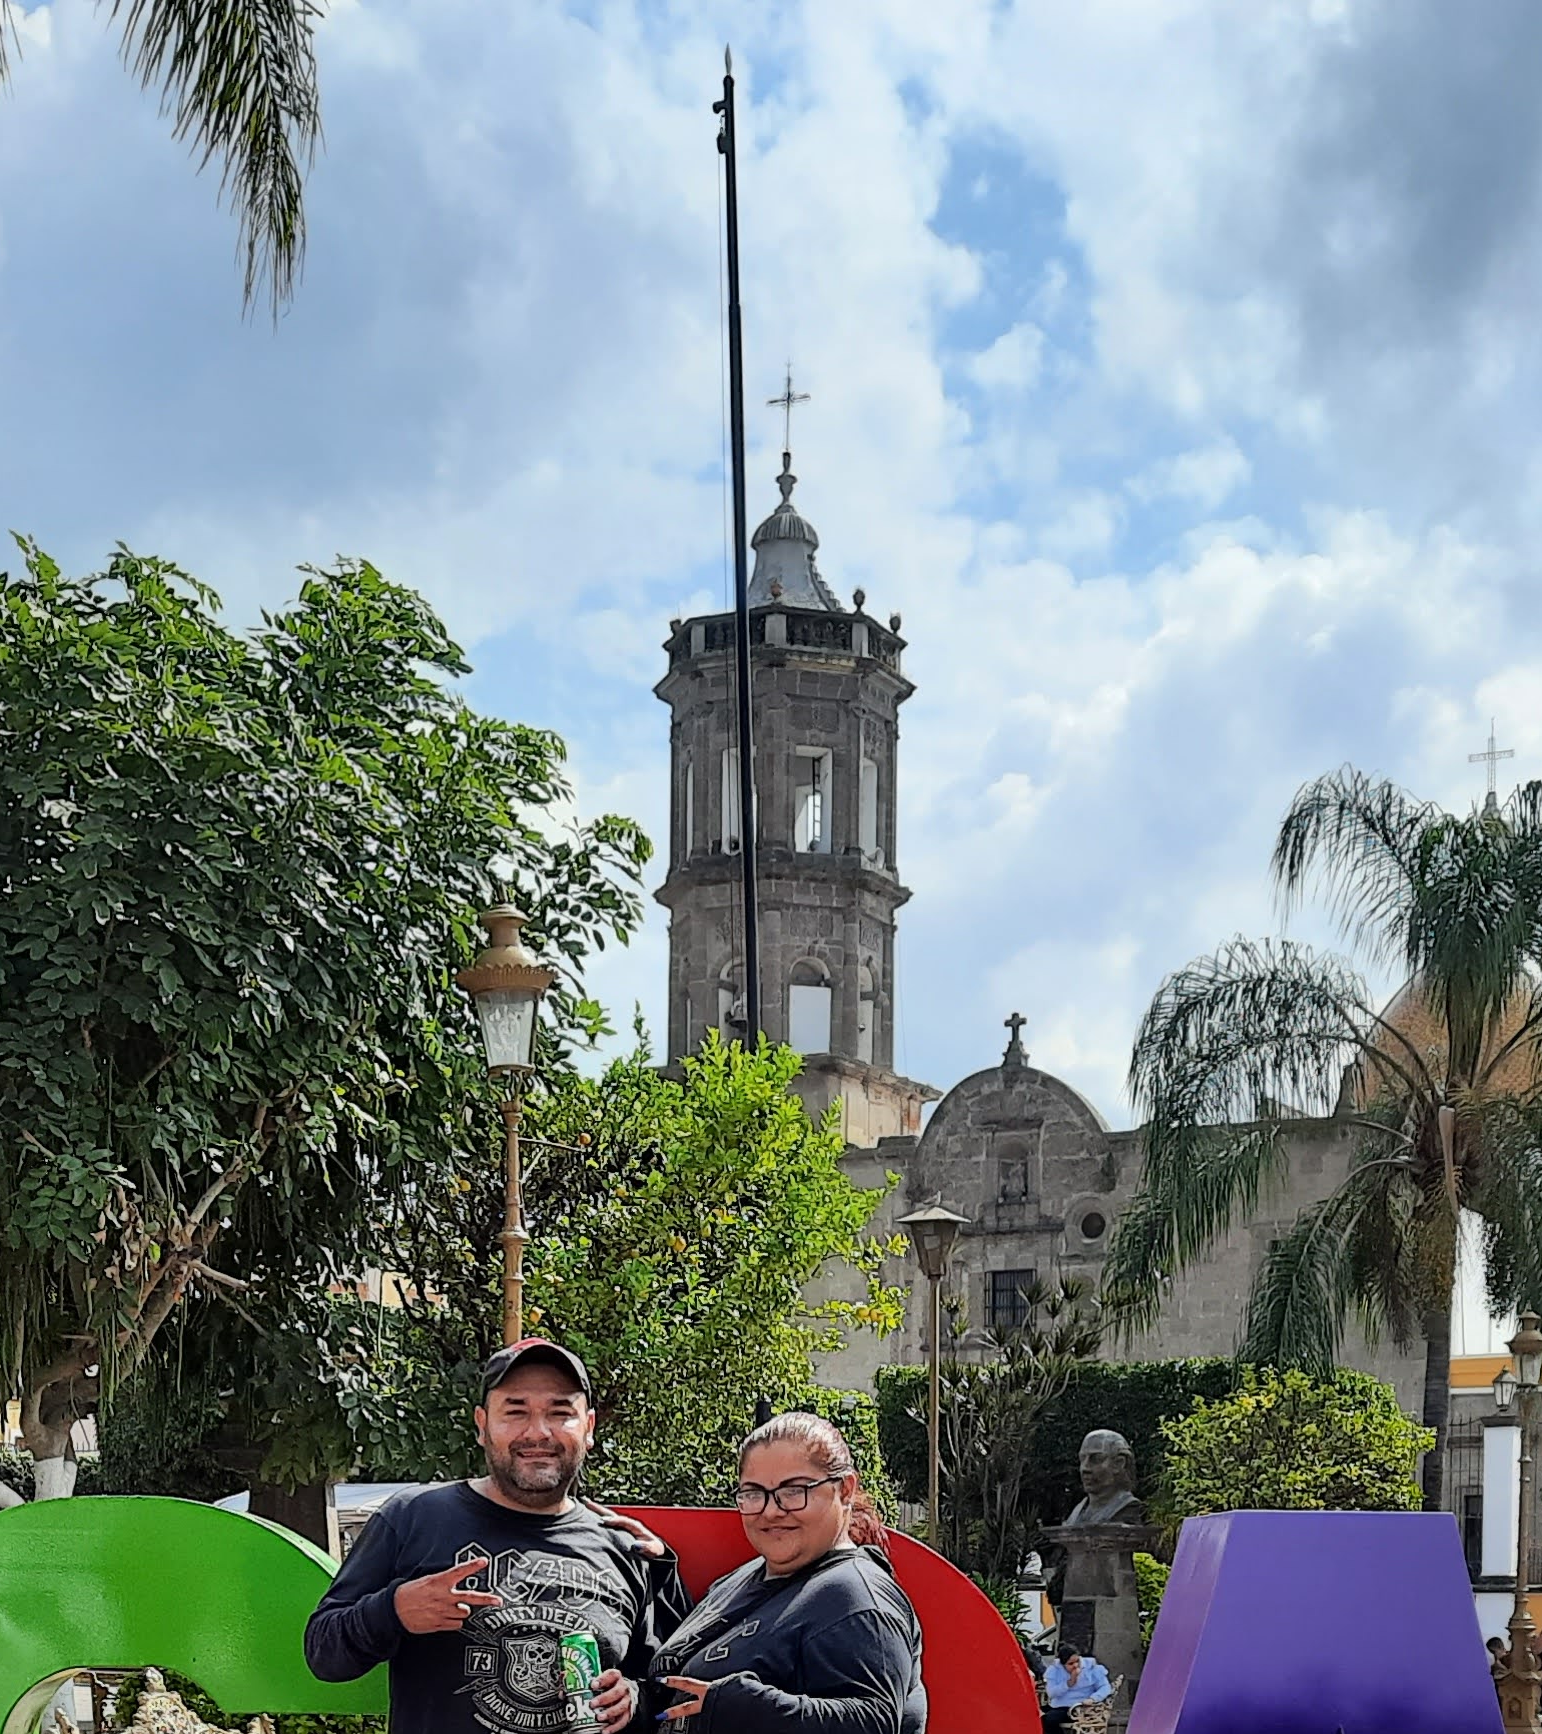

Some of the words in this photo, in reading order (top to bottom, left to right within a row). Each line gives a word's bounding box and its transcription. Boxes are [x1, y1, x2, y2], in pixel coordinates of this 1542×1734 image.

[483, 1605, 537, 1630] DIRTY
[472, 1652, 492, 1671] 73
[482, 1692, 516, 1721] DONE
